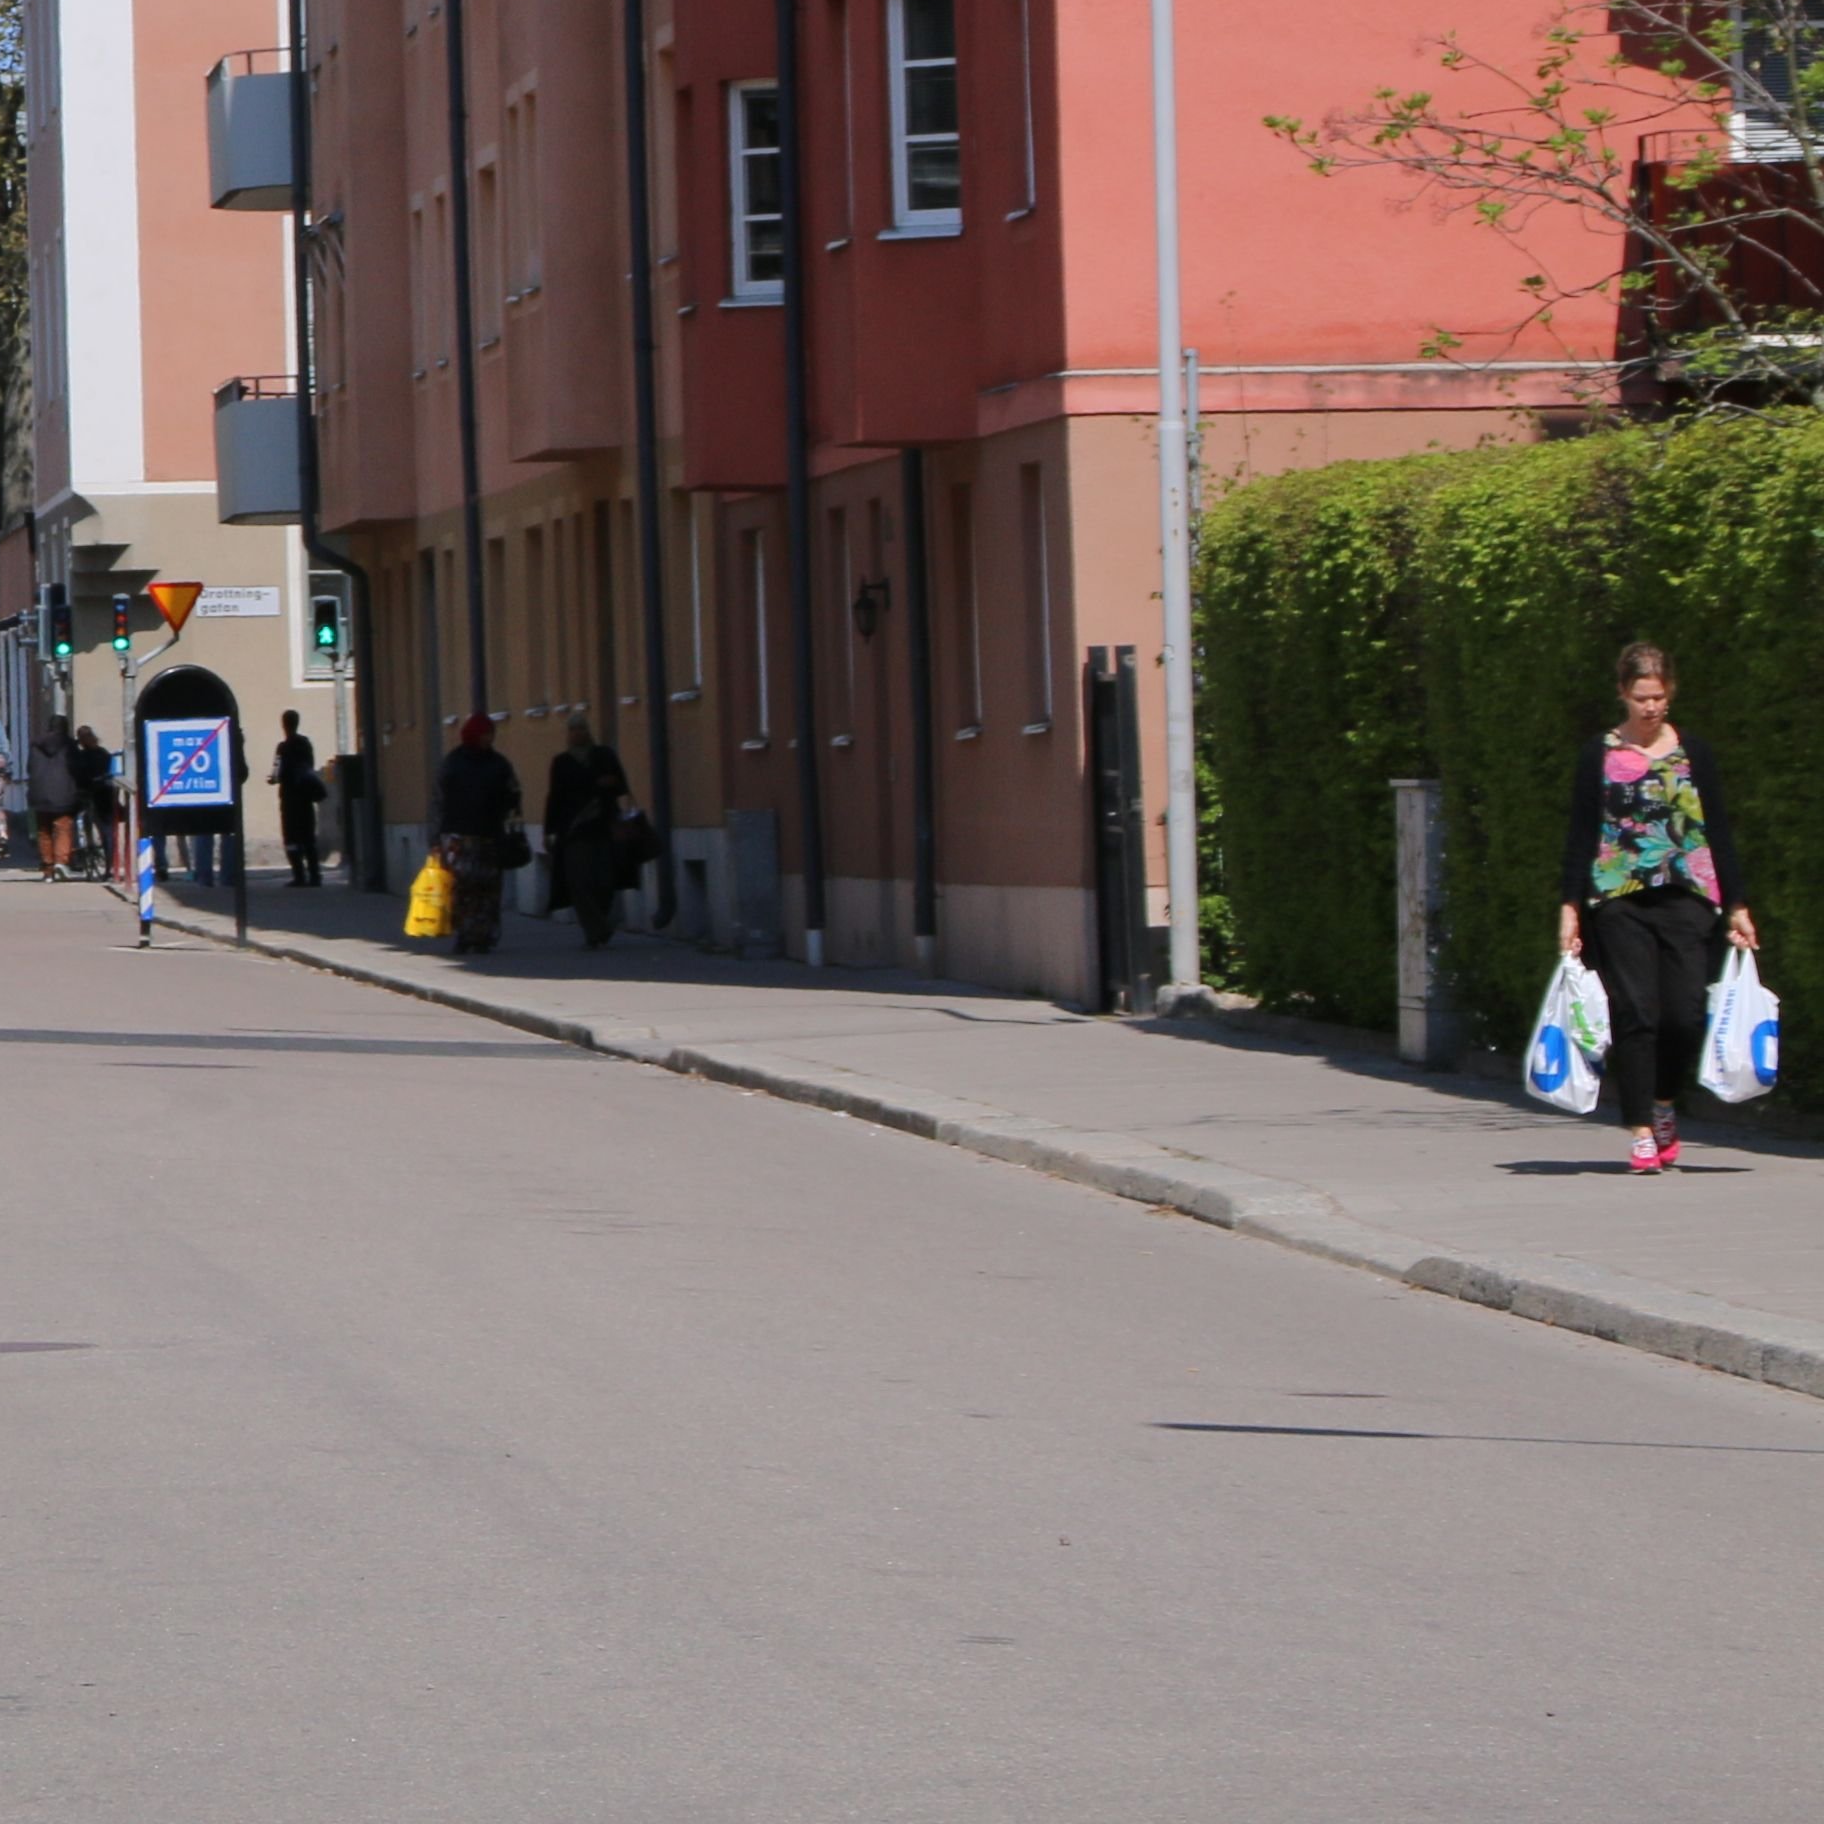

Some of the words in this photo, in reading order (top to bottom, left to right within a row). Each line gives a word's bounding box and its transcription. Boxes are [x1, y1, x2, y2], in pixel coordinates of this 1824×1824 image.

[200, 603, 240, 615] gatan
[173, 737, 204, 747] max
[167, 750, 211, 775] 20
